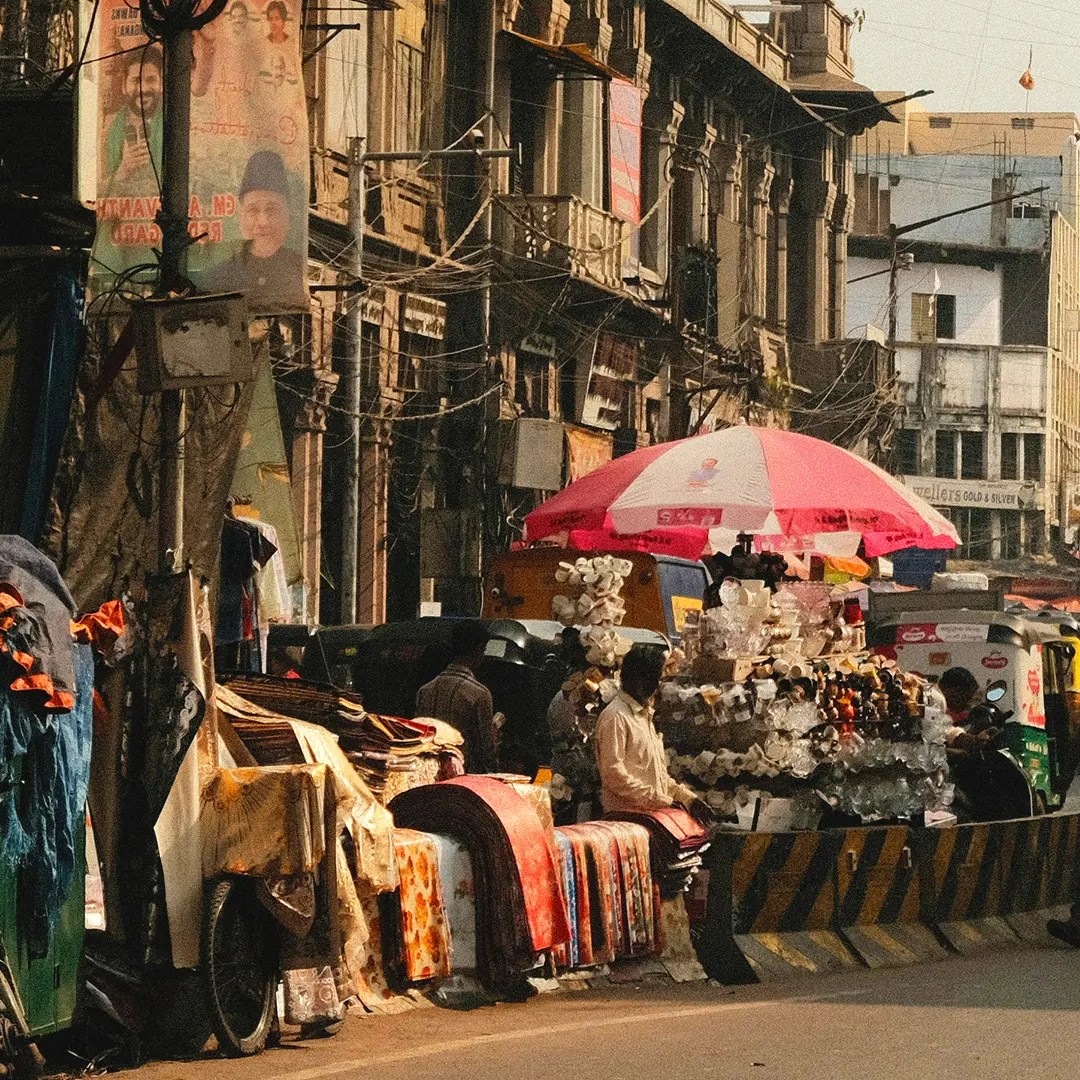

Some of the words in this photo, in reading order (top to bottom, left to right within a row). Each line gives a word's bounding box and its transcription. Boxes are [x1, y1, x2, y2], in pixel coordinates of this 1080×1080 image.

[913, 483, 961, 503] wellers
[963, 491, 982, 501] GOLD
[984, 492, 989, 503] &
[991, 493, 1015, 505] SILVER
